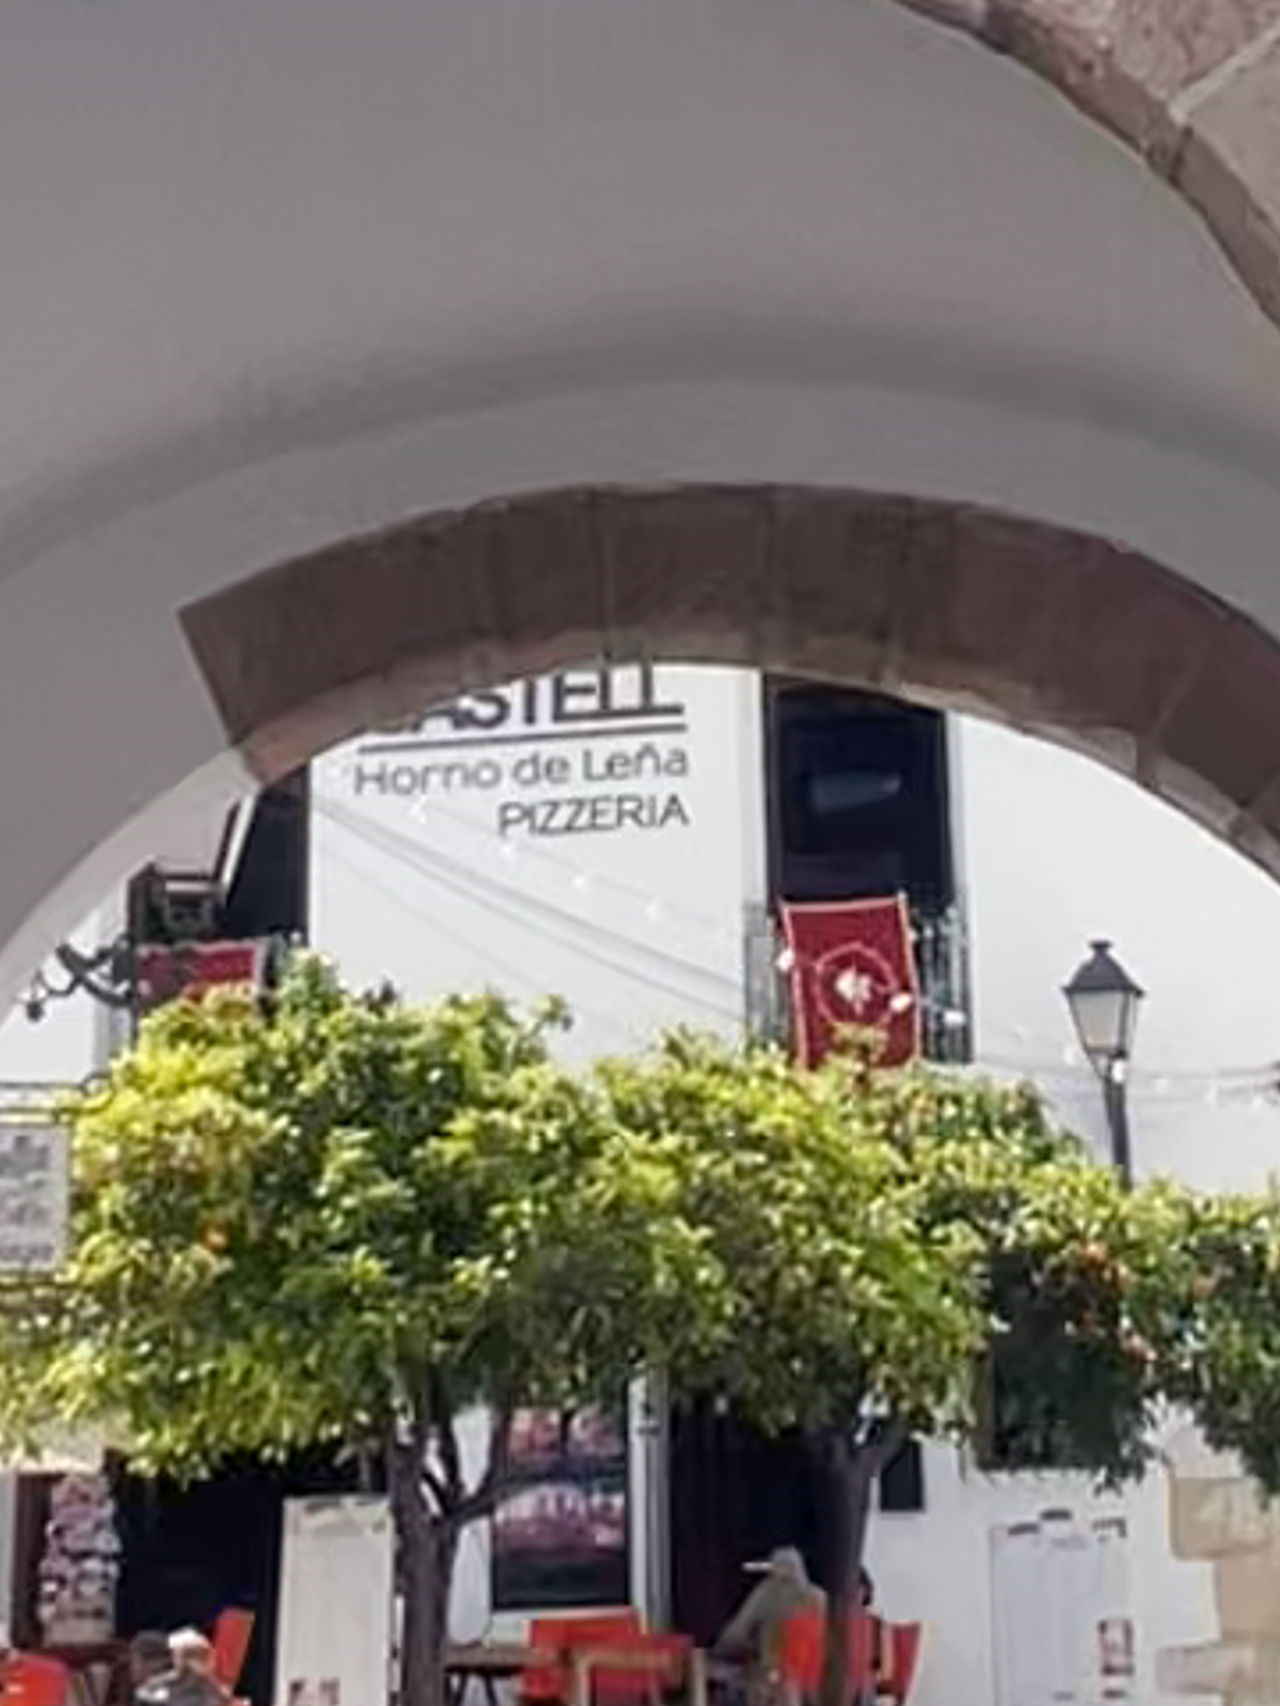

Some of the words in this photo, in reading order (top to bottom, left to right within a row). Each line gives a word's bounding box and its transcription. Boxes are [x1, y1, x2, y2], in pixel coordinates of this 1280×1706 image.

[375, 662, 684, 730] ASTELL
[353, 758, 502, 795] Horno
[510, 750, 571, 787] de
[581, 742, 689, 782] Leña
[496, 790, 690, 837] PIZZERIA
